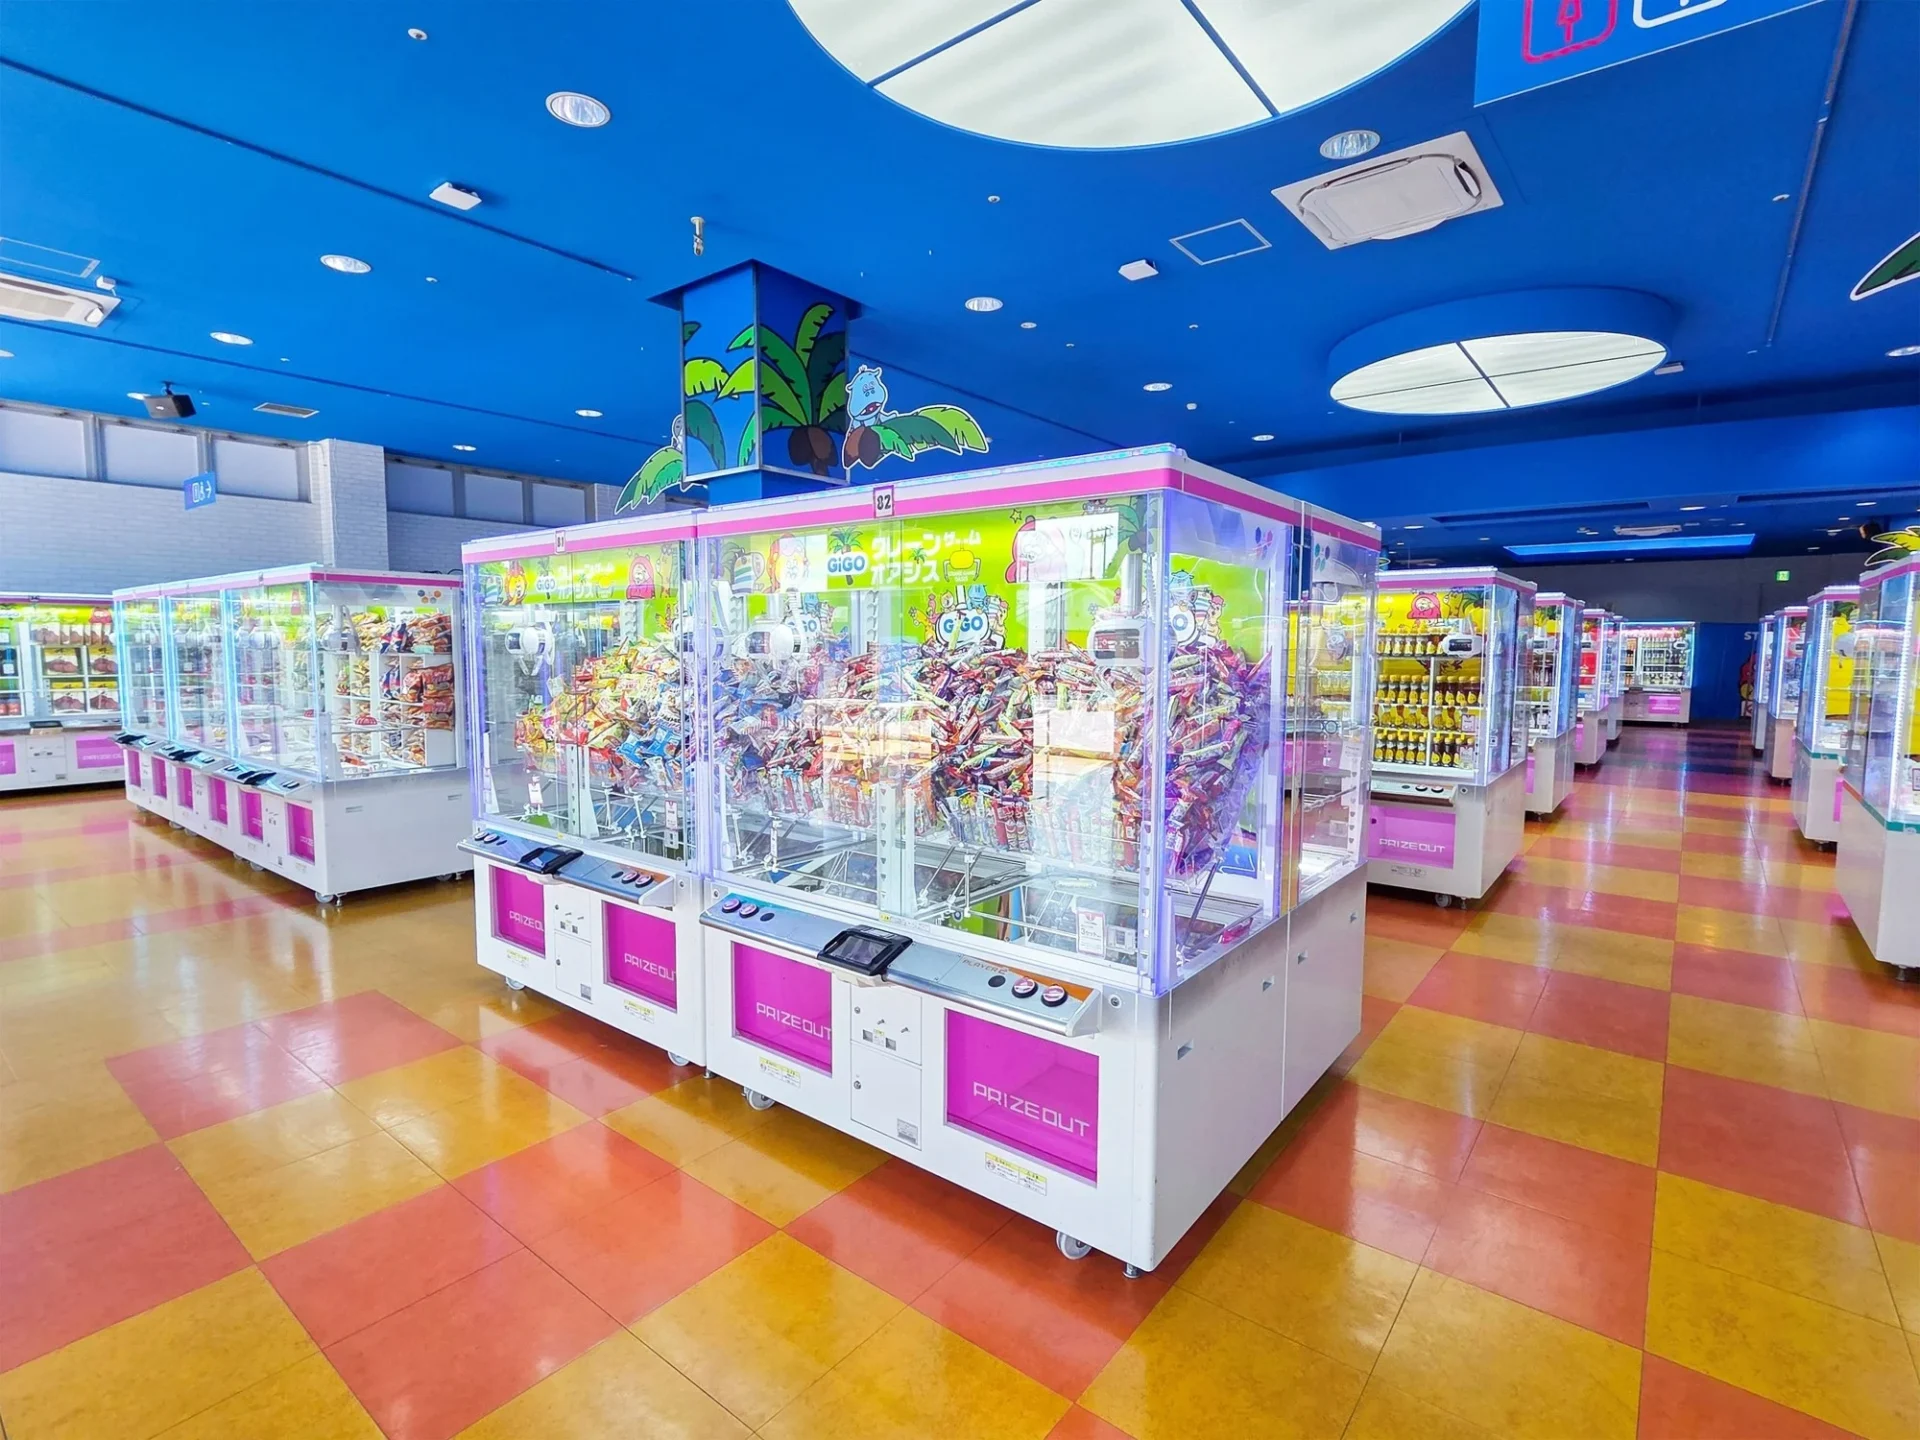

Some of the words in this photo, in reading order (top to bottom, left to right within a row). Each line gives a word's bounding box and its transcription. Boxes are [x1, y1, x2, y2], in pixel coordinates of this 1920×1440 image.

[877, 494, 892, 511] 82
[871, 532, 941, 559] クレーン
[943, 529, 982, 545] ゲーム
[827, 555, 866, 574] GiGO
[870, 560, 941, 585] オアシス
[943, 616, 984, 634] GGO
[1379, 838, 1446, 854] PRIZEOUT
[509, 910, 544, 932] PRIZEO
[624, 952, 676, 982] PRIZEOU
[962, 959, 999, 973] PLAYER
[756, 1002, 832, 1041] PRIZEOUT
[973, 1081, 1090, 1138] PRIZEOUT
